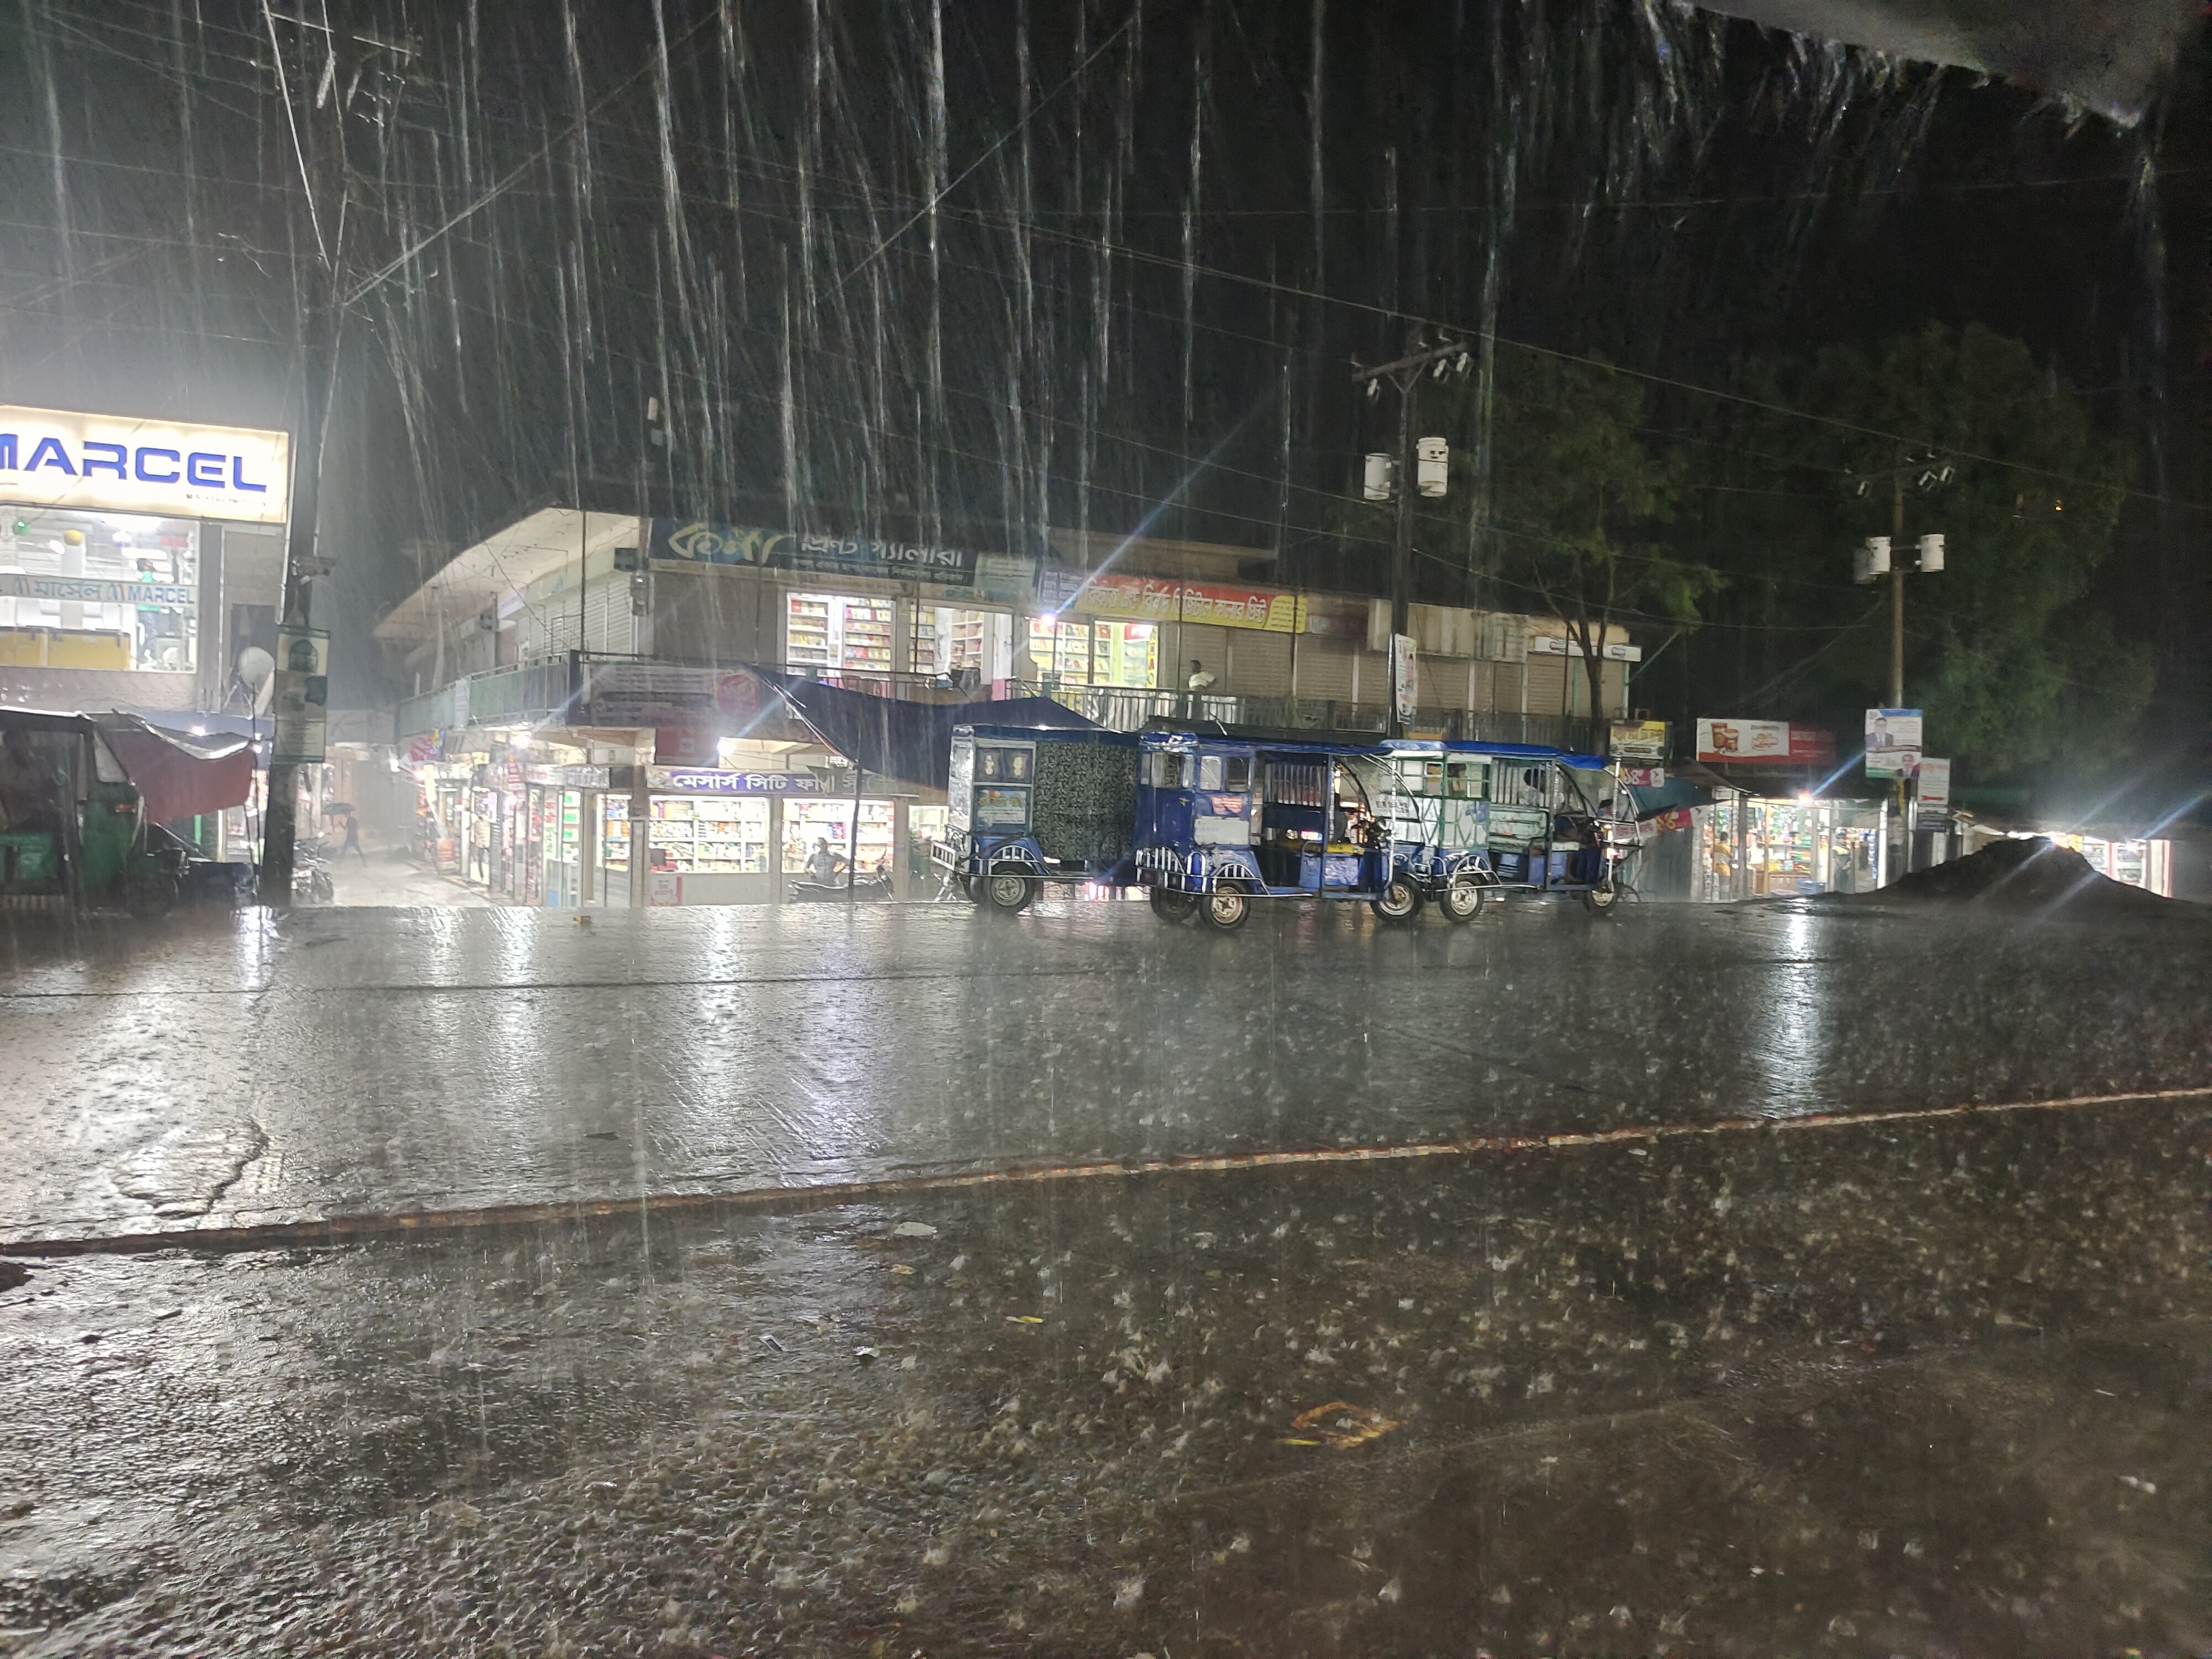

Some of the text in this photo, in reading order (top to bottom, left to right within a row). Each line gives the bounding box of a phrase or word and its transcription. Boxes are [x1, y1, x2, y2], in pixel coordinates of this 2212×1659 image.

[34, 580, 102, 600] মার্সেল
[128, 586, 195, 604] MARCEL
[672, 773, 741, 790] মেসার্স
[744, 774, 789, 791] সিটি
